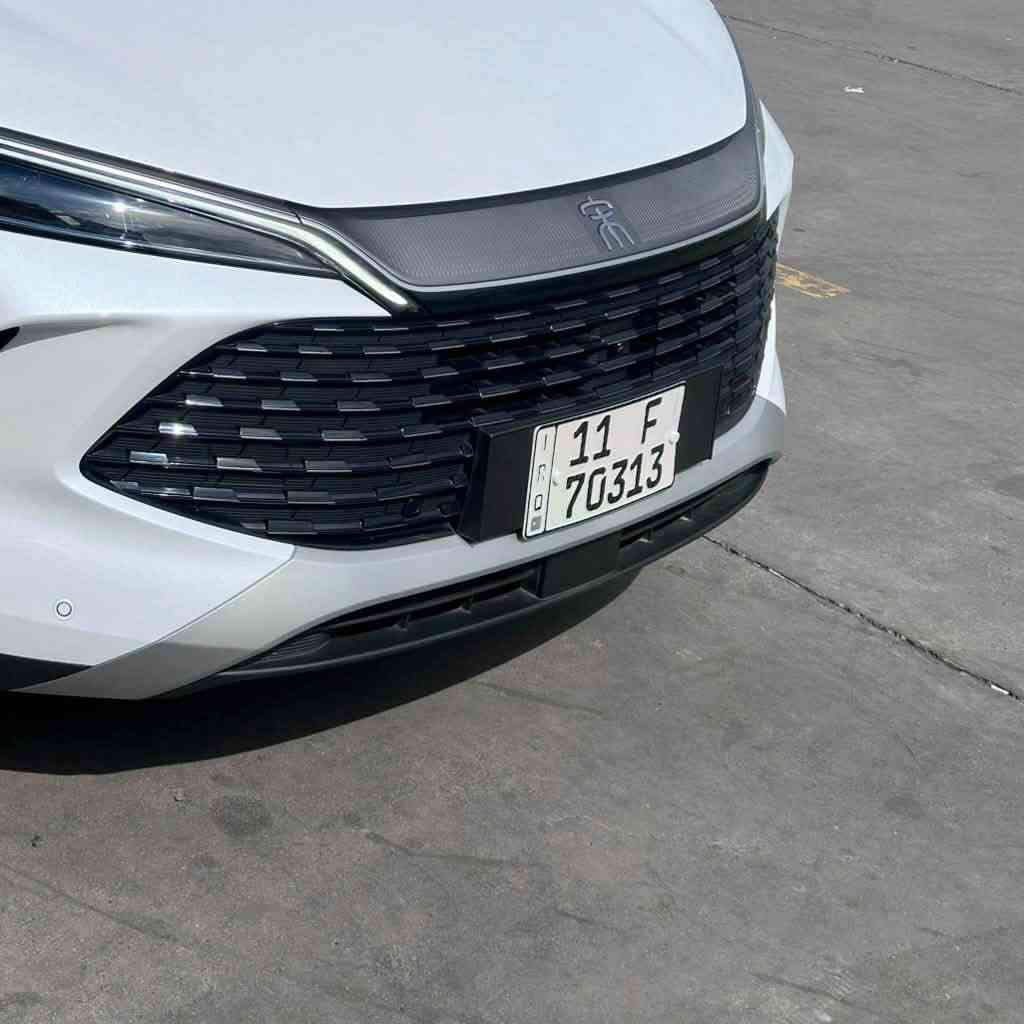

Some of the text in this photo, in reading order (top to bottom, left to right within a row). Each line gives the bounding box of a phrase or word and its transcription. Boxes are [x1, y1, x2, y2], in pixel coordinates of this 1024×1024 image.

[570, 397, 663, 466] 11 F
[565, 443, 665, 519] 70313
